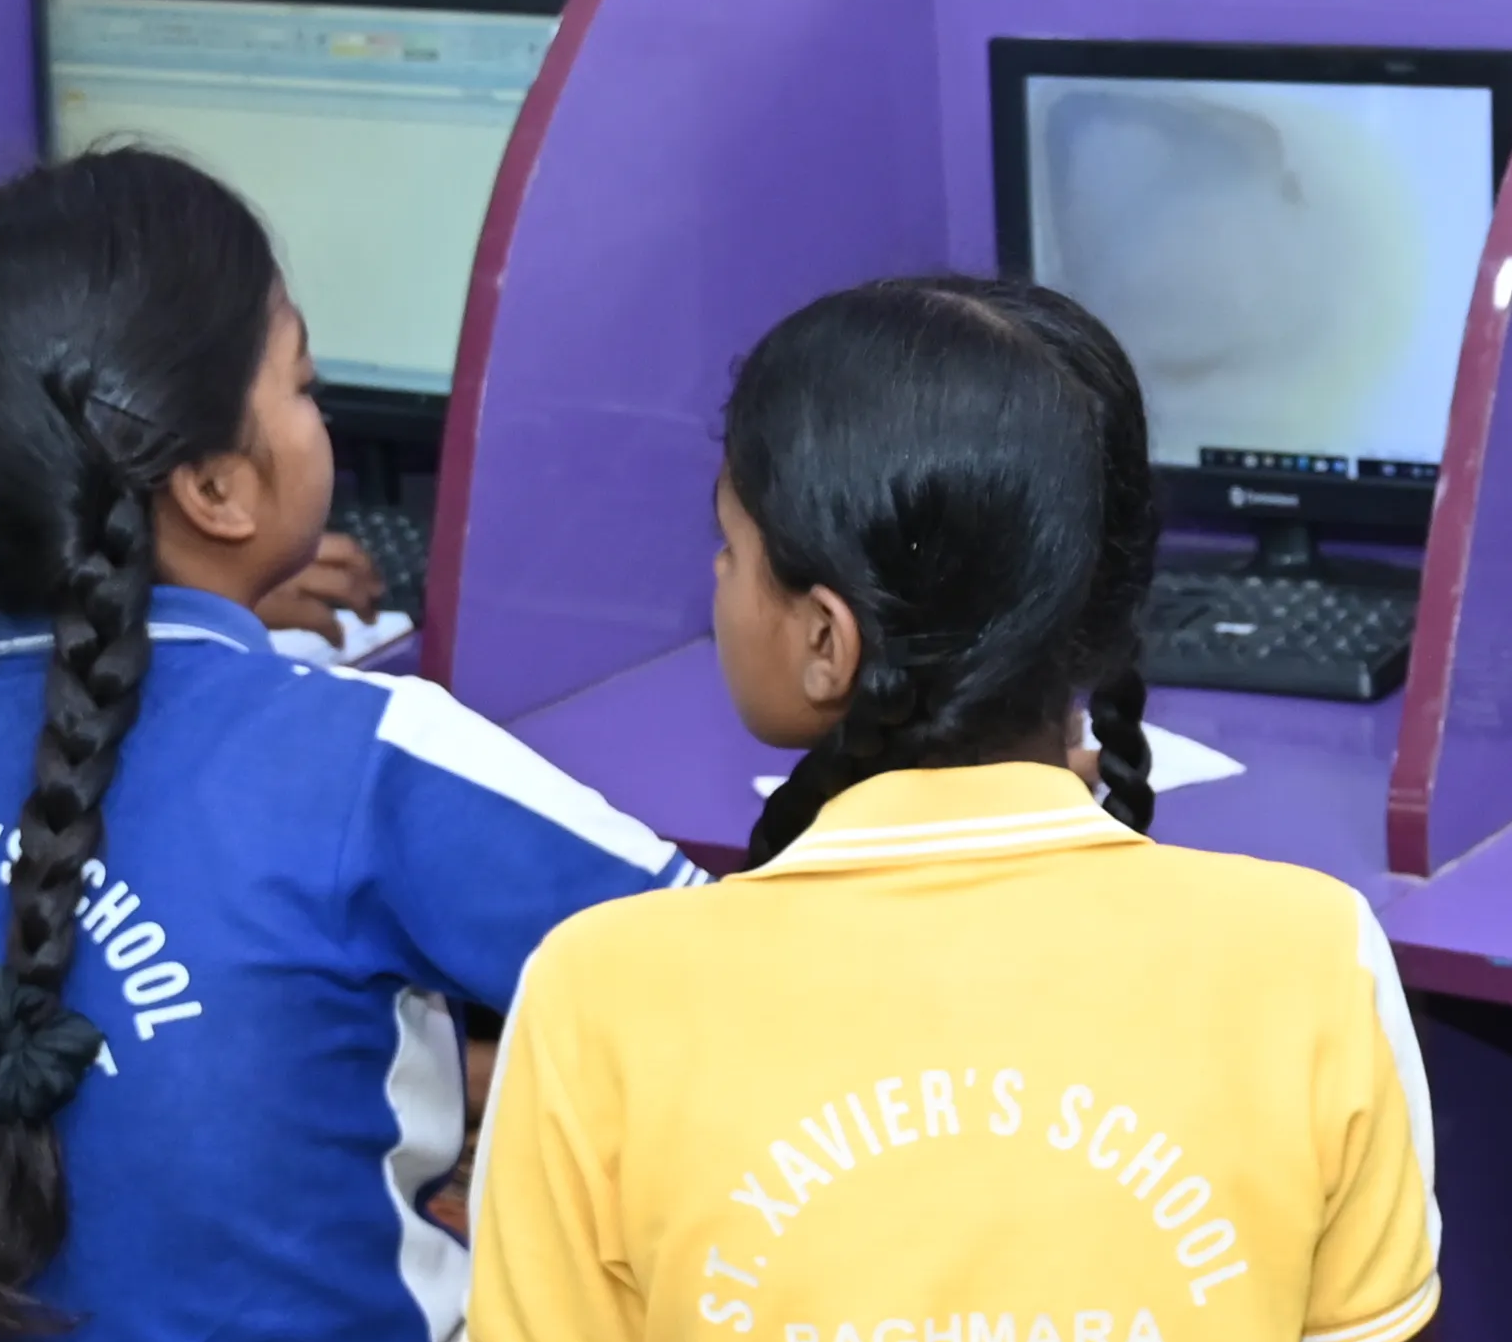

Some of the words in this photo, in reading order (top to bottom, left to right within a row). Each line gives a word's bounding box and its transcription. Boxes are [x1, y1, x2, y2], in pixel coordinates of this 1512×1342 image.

[729, 1066, 1026, 1237] XAVIER'S
[1046, 1082, 1249, 1308] SCHOOL
[698, 1244, 768, 1334] ST.
